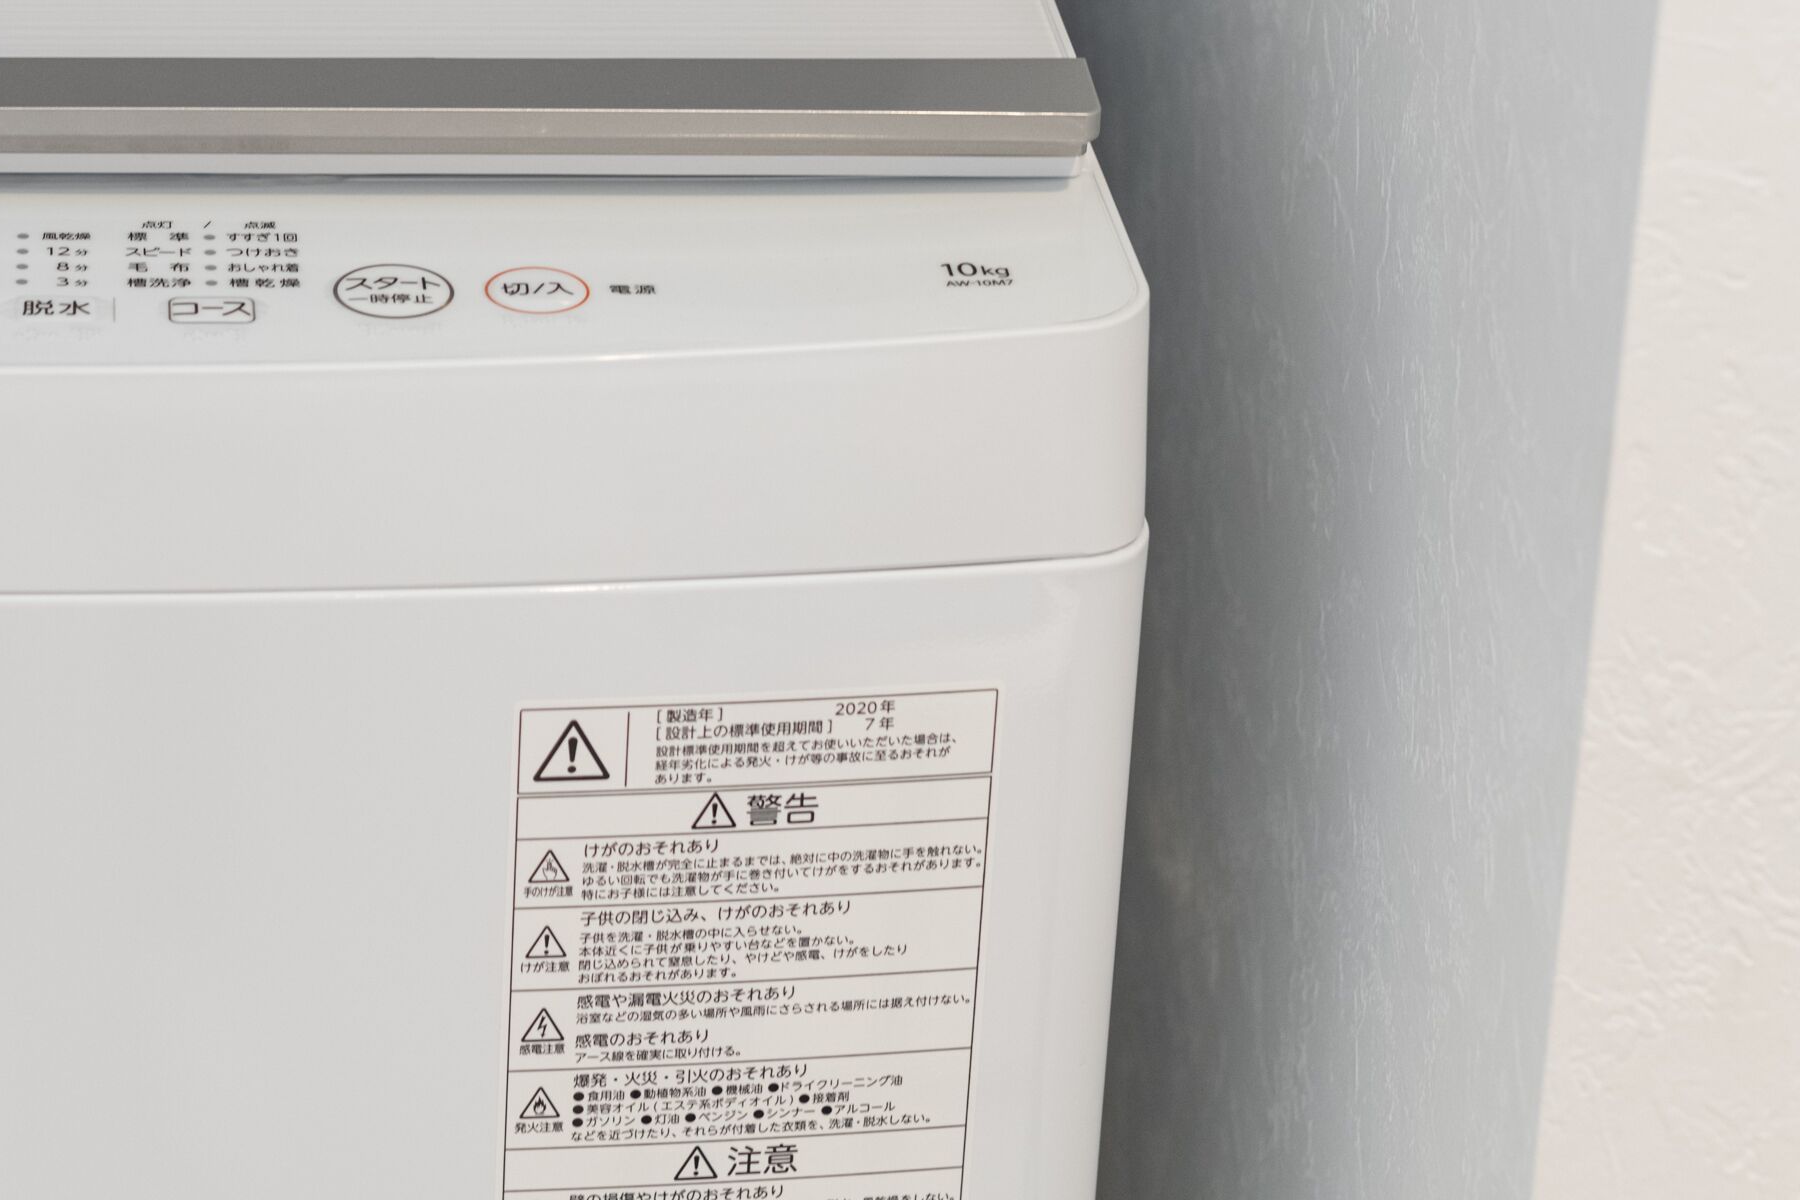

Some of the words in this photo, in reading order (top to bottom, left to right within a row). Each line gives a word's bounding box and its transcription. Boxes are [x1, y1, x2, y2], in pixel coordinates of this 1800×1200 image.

[142, 220, 173, 229] 点灯
[125, 246, 192, 257] スピード
[226, 247, 298, 257] つけおき
[228, 262, 299, 273] おしゃれ着
[940, 262, 1010, 278] 10kg
[127, 277, 191, 288] 槽洗浄
[229, 277, 300, 288] 槽乾燥
[345, 276, 441, 291] スタート
[502, 282, 575, 297] 切/入
[608, 284, 656, 295] 電源
[349, 293, 434, 304] 一時停止
[22, 300, 91, 316] 脱水
[172, 301, 251, 316] コース
[654, 772, 712, 784] あります。
[746, 791, 819, 826] 警告
[583, 838, 720, 858] けがのおそれあり
[523, 885, 574, 898] 手のけが注意
[580, 881, 779, 901] 特にお子様には注意してください。
[579, 899, 851, 927] 子供の閉じ込み、けがのおそれあり
[579, 924, 803, 945] 子供を洗濯・脱水槽の中に入らせない。
[520, 960, 570, 974] けが注意
[577, 967, 737, 984] おぼれるおそれがあります。
[576, 985, 796, 1010] 感電や漏電火災のおそれあり
[574, 1028, 710, 1049] 感電のおそれあり
[519, 1042, 566, 1055] 感電注意
[574, 1046, 742, 1064] アース線を確実に取り付ける。
[573, 1063, 808, 1088] 爆発・火災・引火のおそれあり
[588, 1090, 625, 1102] 食用油
[643, 1086, 707, 1099] 動植物系油
[726, 1083, 763, 1095] 機械油
[780, 1074, 903, 1093] ドライクリーニング油
[812, 1091, 850, 1104] 接着剤
[586, 1115, 636, 1128] ガソリン
[654, 1113, 680, 1125] 灯油
[766, 1106, 815, 1120] シンナー
[834, 1101, 897, 1115] アルコール
[515, 1121, 564, 1134] 発火注意
[727, 1143, 799, 1177] 注意
